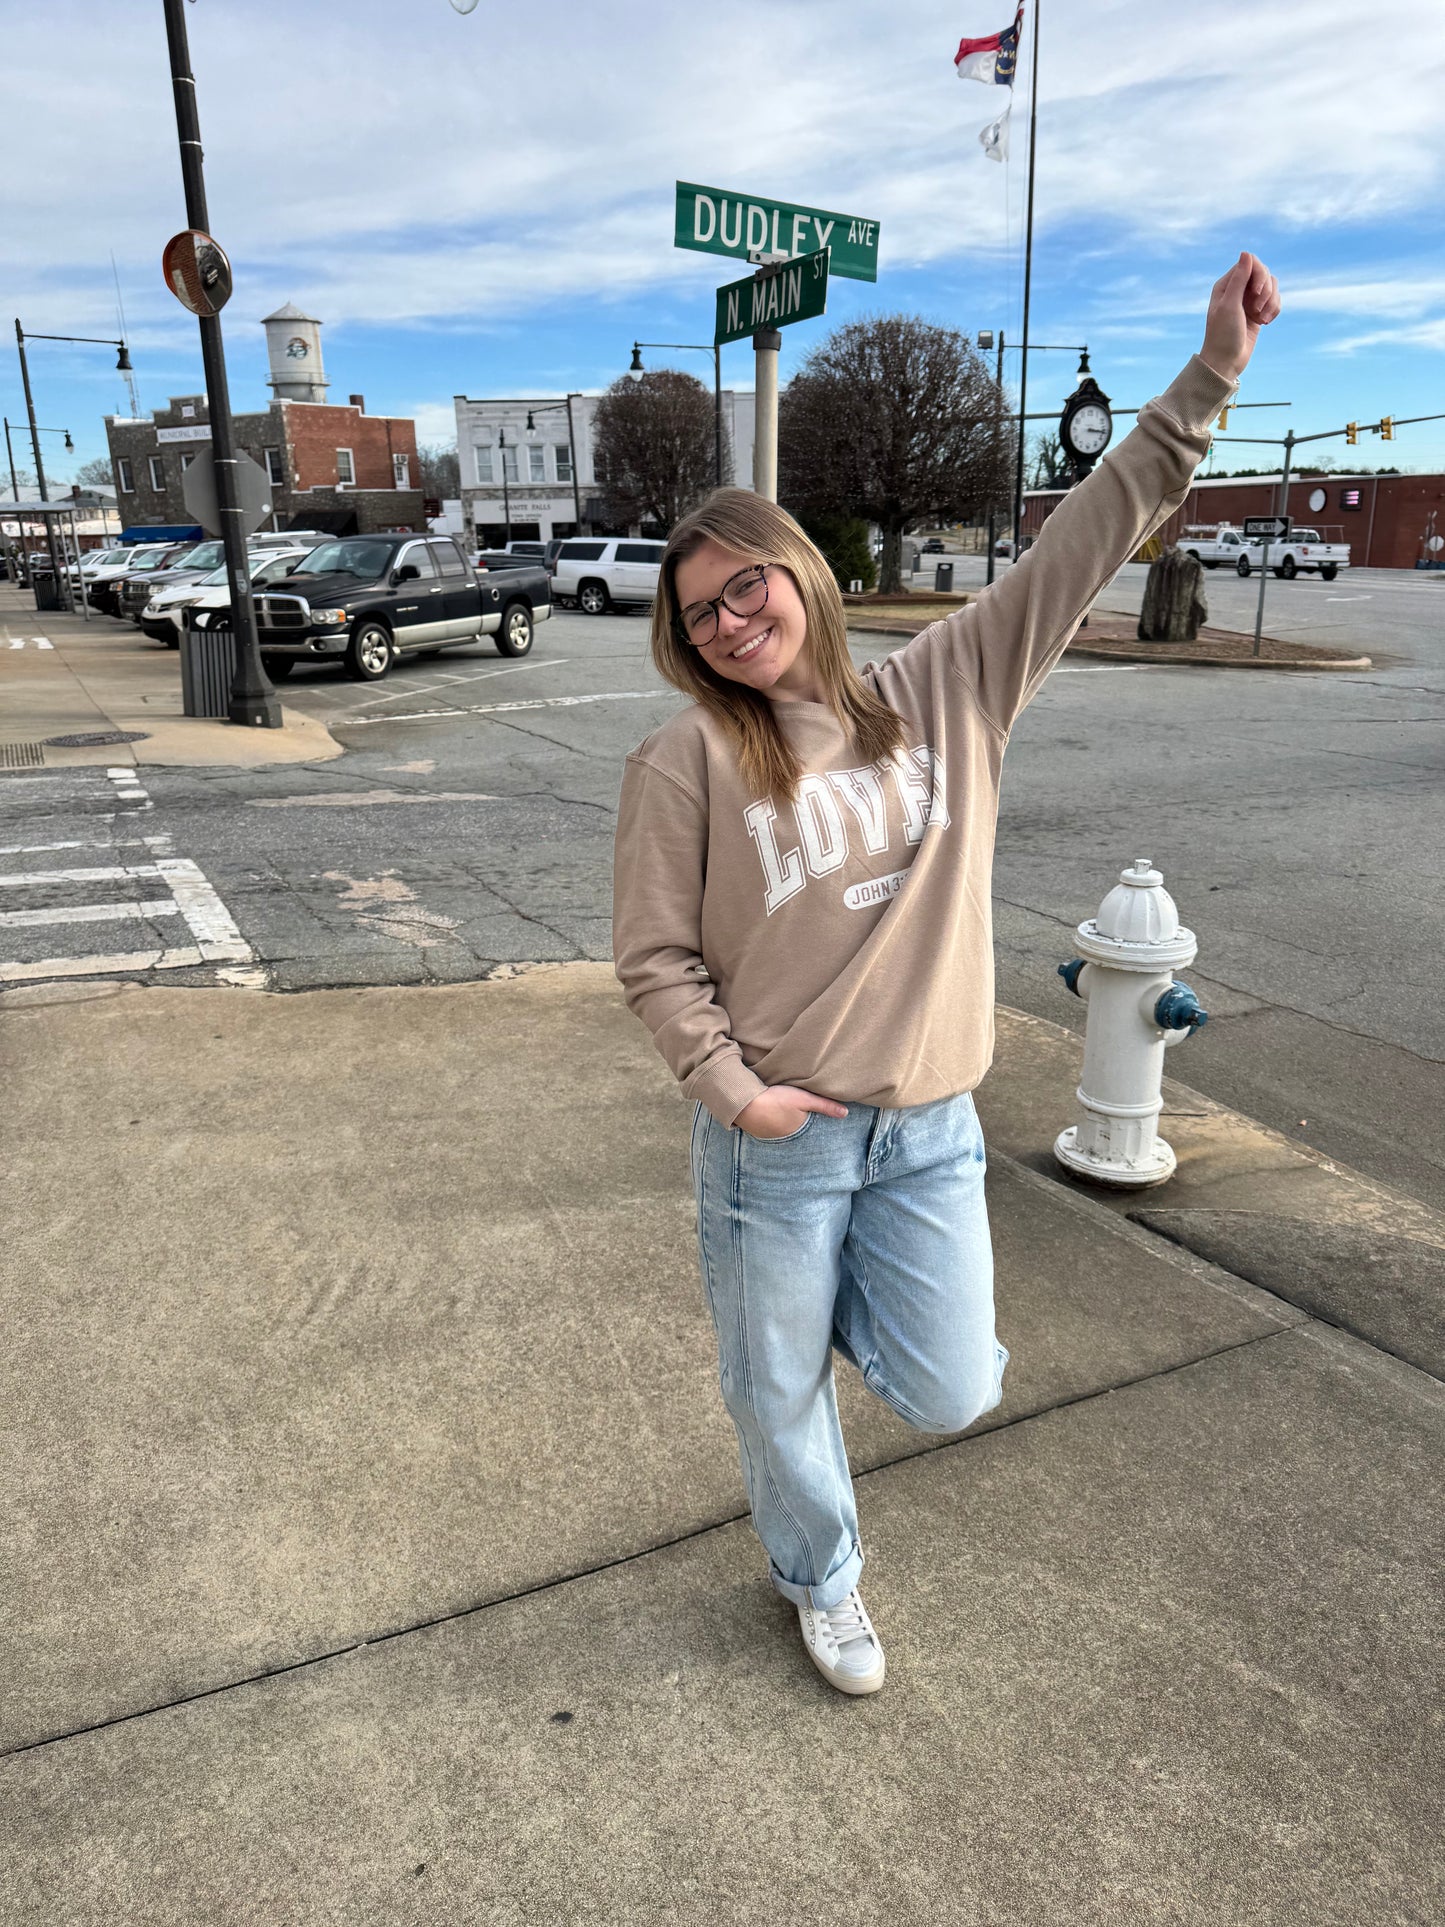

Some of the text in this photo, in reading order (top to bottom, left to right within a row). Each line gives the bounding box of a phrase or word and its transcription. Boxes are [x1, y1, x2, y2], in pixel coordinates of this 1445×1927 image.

[694, 193, 875, 258] DUDLEY AVE
[726, 253, 825, 334] N. MAIN ST
[1249, 523, 1276, 531] ONE WAY
[743, 745, 952, 918] LOVE
[852, 880, 891, 905] JOHN
